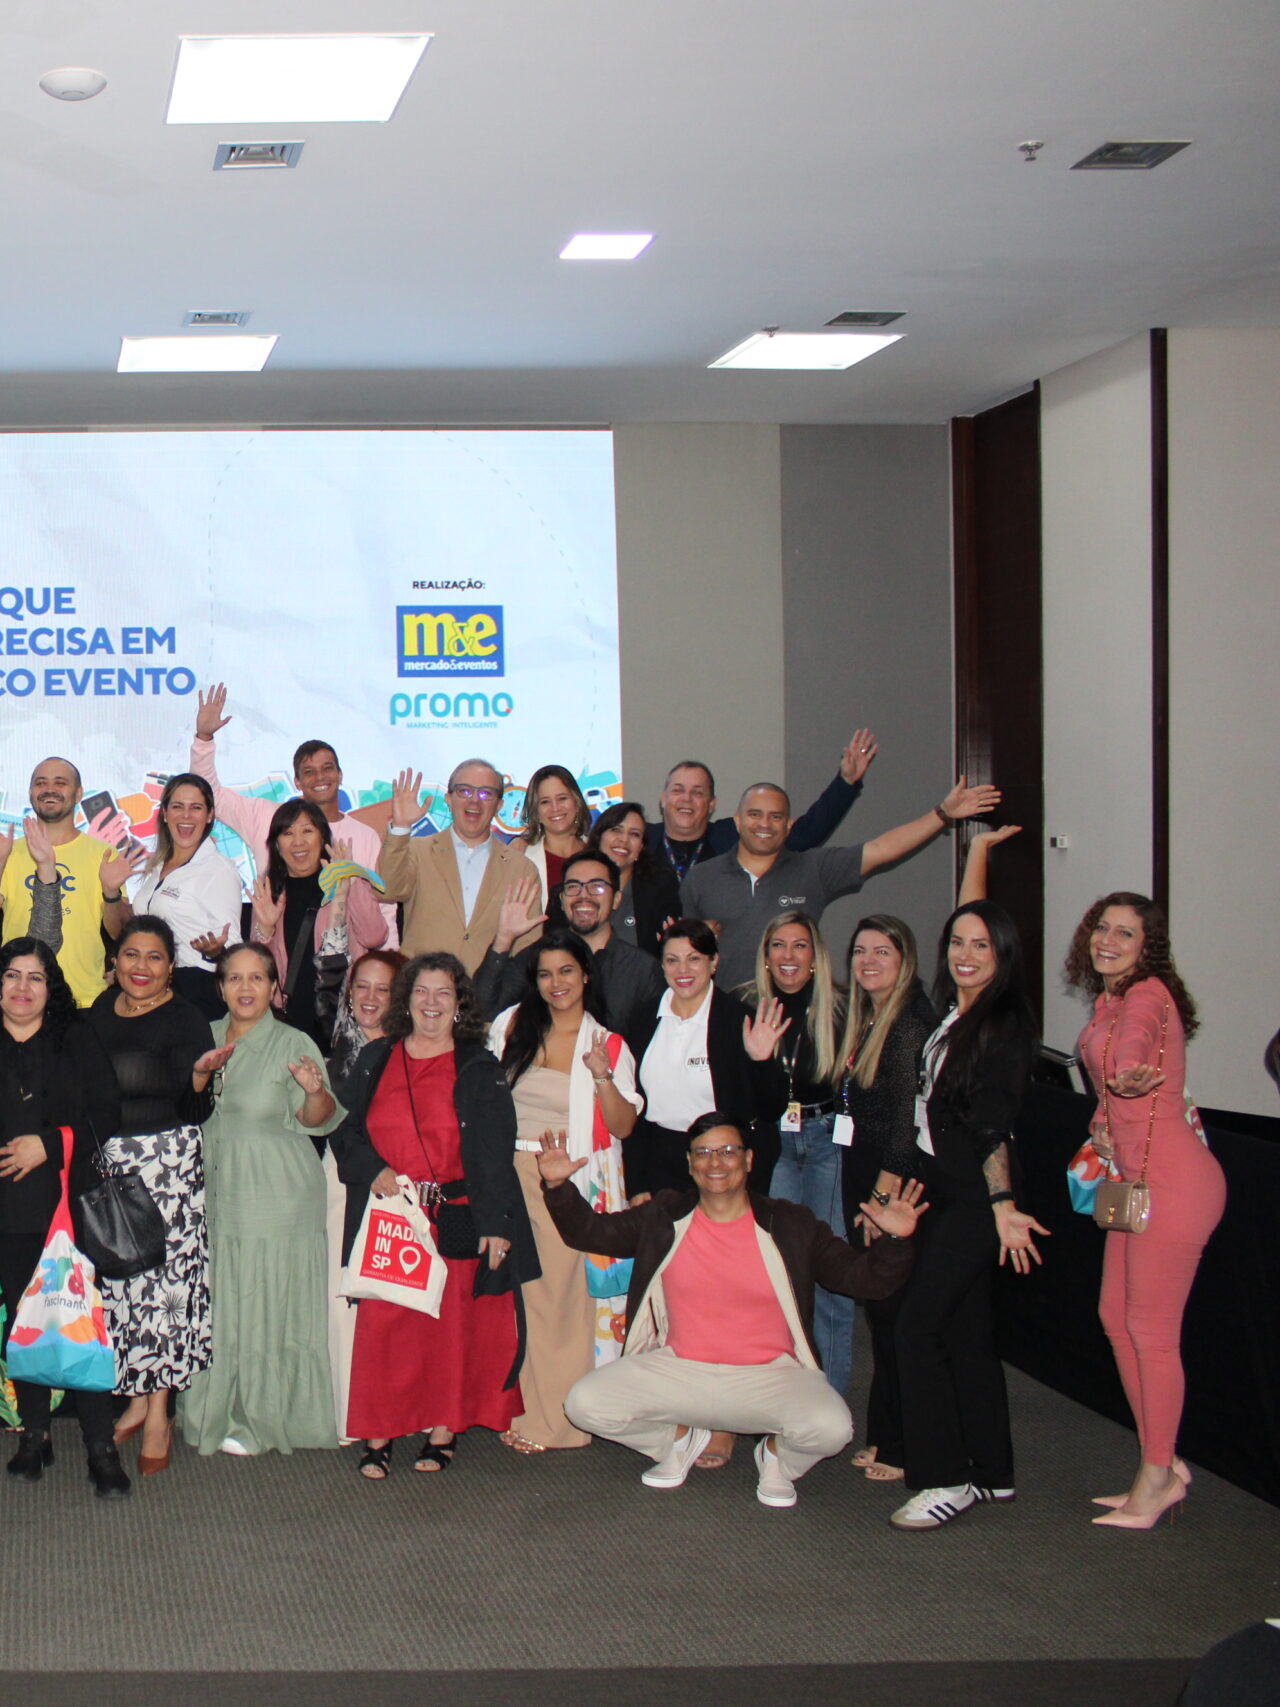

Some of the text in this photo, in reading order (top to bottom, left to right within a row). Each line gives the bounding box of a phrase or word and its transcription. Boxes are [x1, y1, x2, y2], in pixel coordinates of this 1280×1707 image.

[412, 578, 486, 592] REALIZAÇÃO:
[121, 626, 176, 655] EM
[44, 666, 196, 696] EVENTO
[390, 691, 514, 726] promo
[24, 874, 76, 892] CC
[374, 1236, 392, 1253] IN
[370, 1254, 392, 1270] SP
